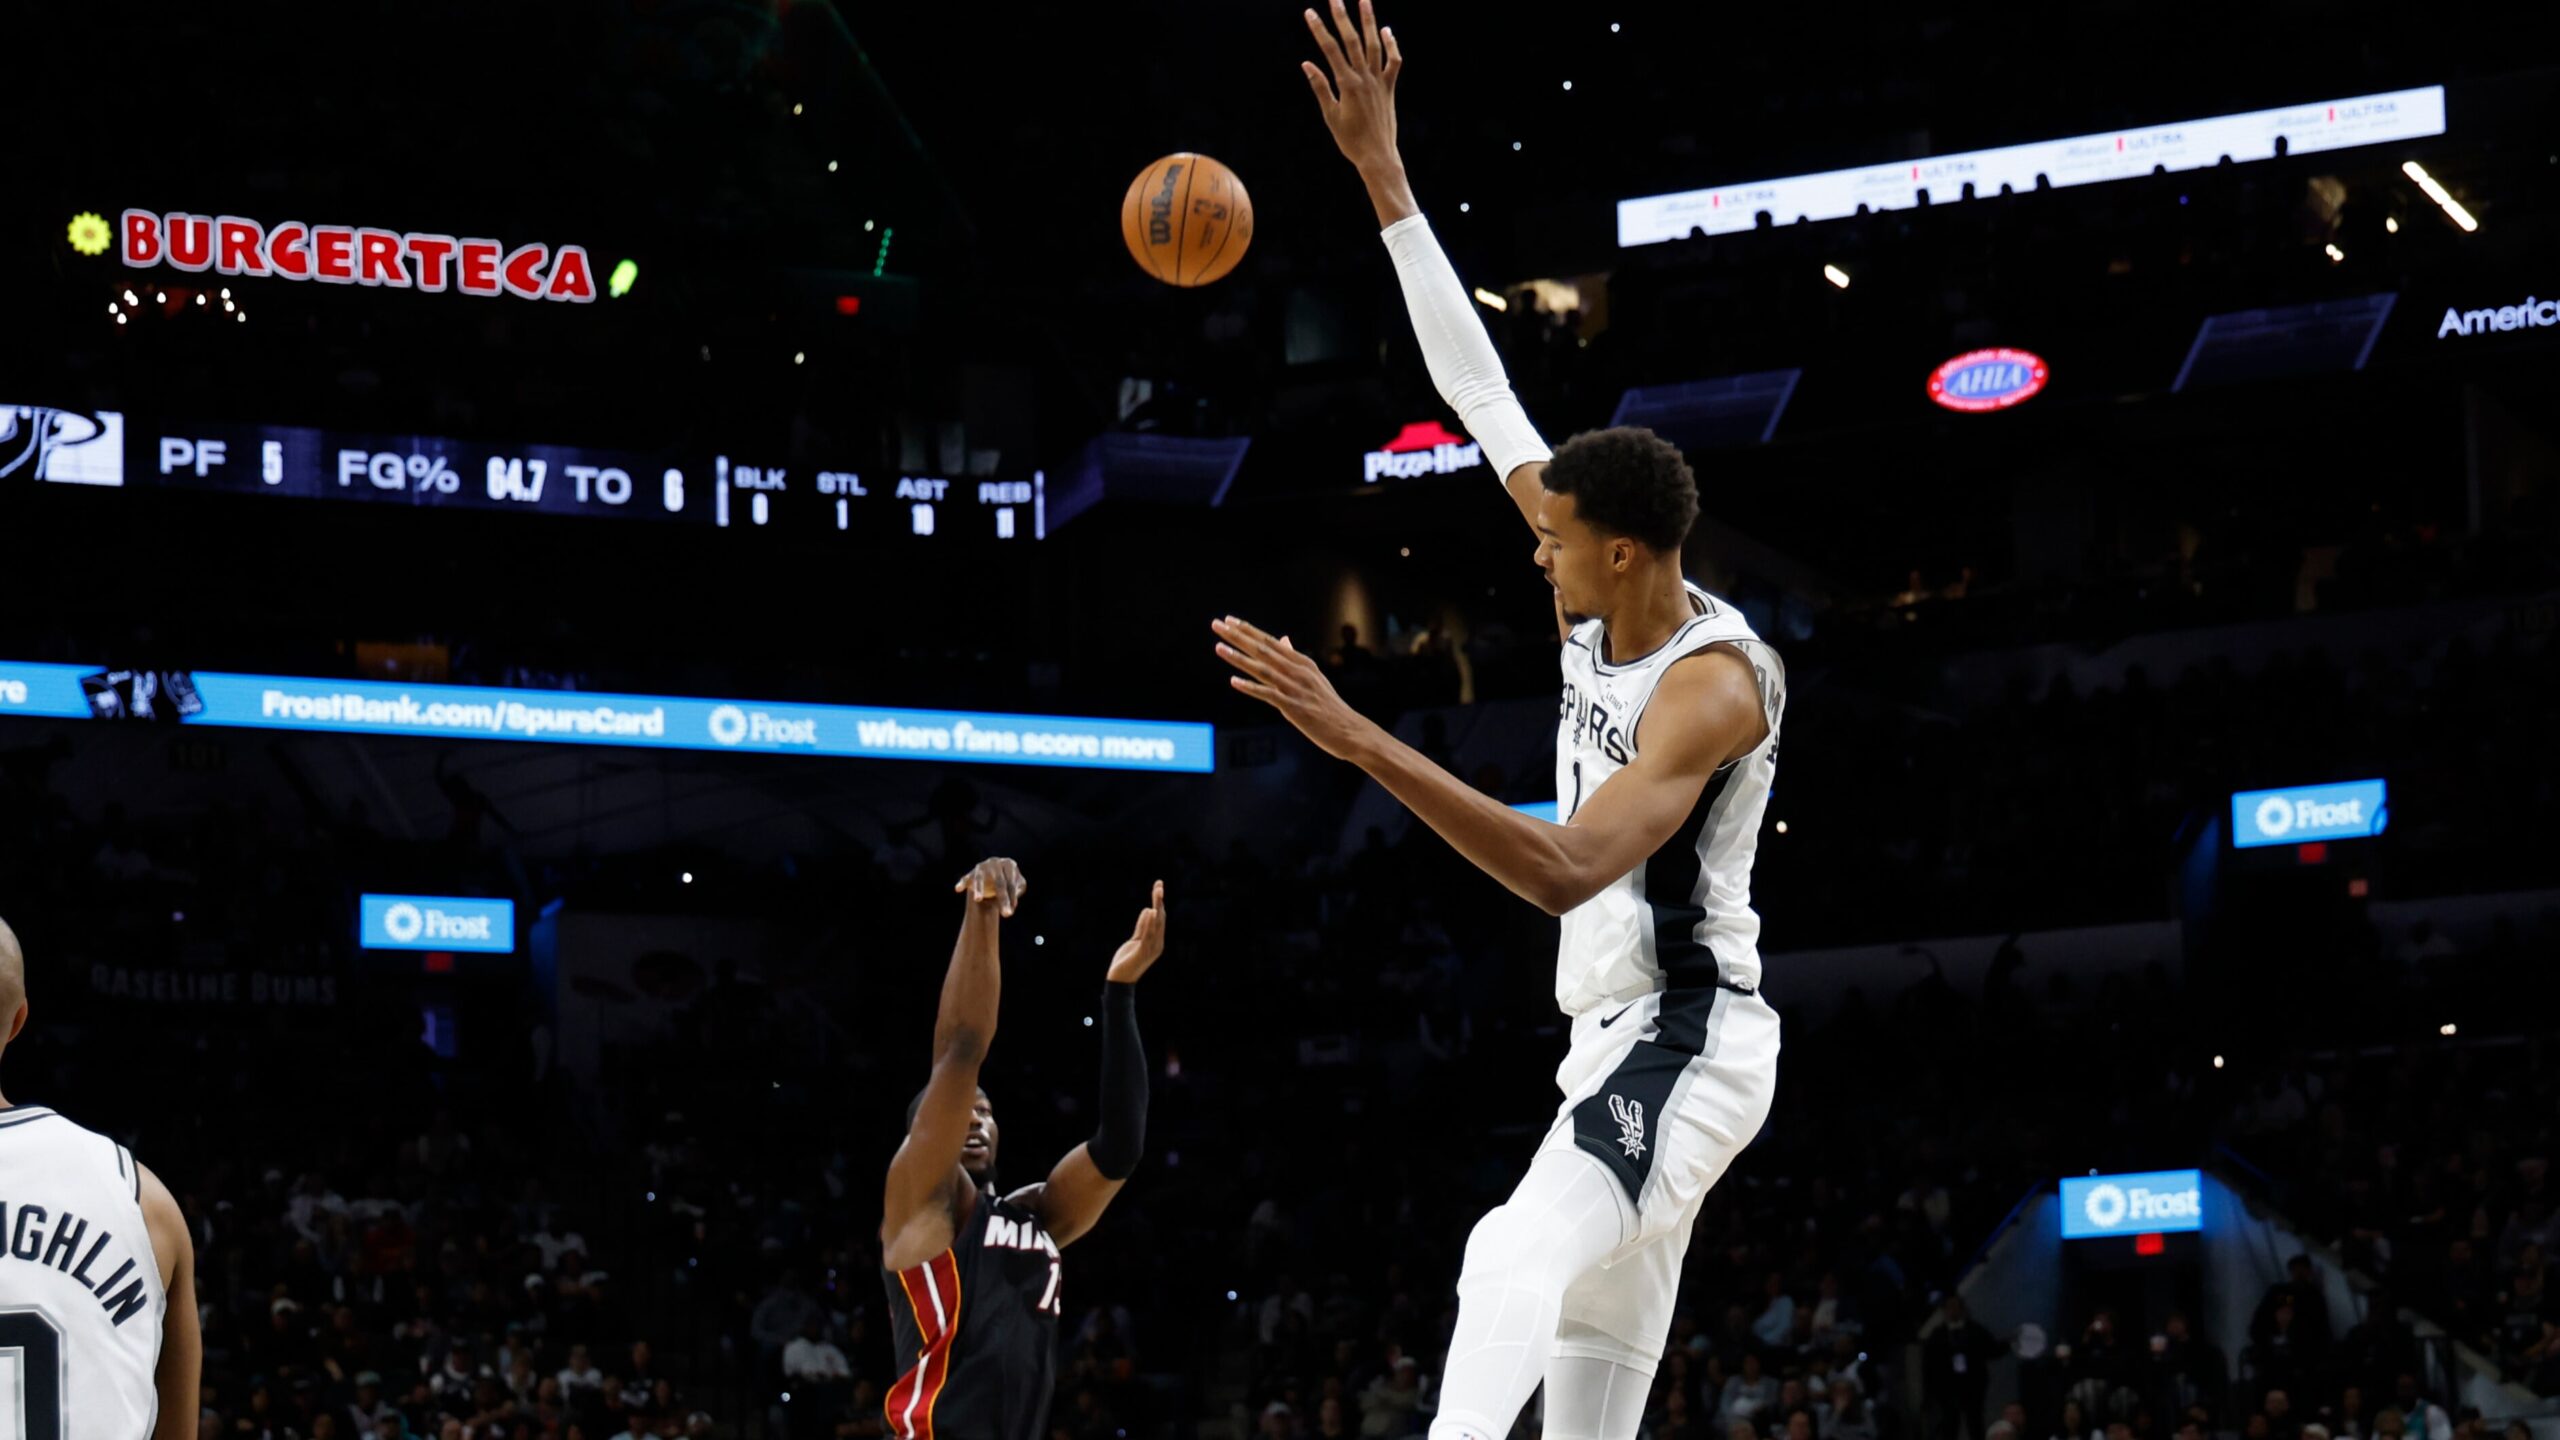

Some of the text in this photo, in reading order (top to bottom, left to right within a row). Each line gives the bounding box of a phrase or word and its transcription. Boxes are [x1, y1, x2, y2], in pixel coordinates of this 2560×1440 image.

[121, 207, 596, 303] BURGERTECA
[2437, 295, 2560, 339] Americ
[160, 437, 684, 512] PF 5 FG% 64.7 TO 6
[1364, 441, 1483, 482] Pizza Hut
[734, 466, 1032, 504] BLK STL AST REB
[836, 498, 848, 530] 1
[262, 690, 665, 737] FrostBank.com/SpursCard
[749, 712, 817, 745] Frost
[857, 718, 1175, 761] Where fans score more
[2296, 798, 2363, 829] Frost
[425, 908, 491, 941] Frost
[2128, 1186, 2200, 1219] Frost
[1037, 1262, 1062, 1316] 1
